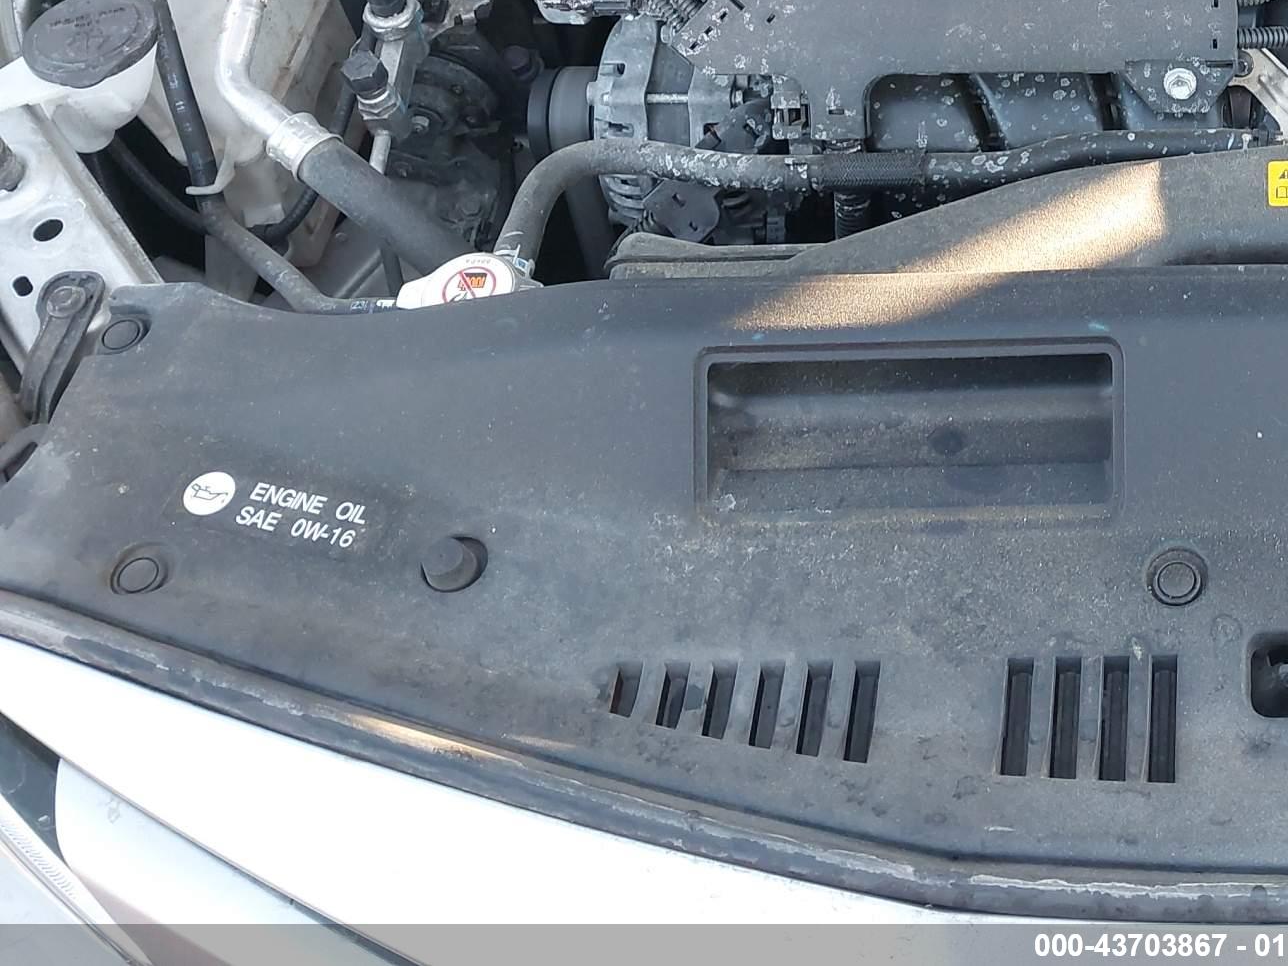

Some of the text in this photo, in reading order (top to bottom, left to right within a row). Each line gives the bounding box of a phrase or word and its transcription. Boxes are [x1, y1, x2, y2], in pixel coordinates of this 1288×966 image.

[249, 482, 366, 525] ENGINE OIL
[235, 506, 356, 548] SAE 0W-16
